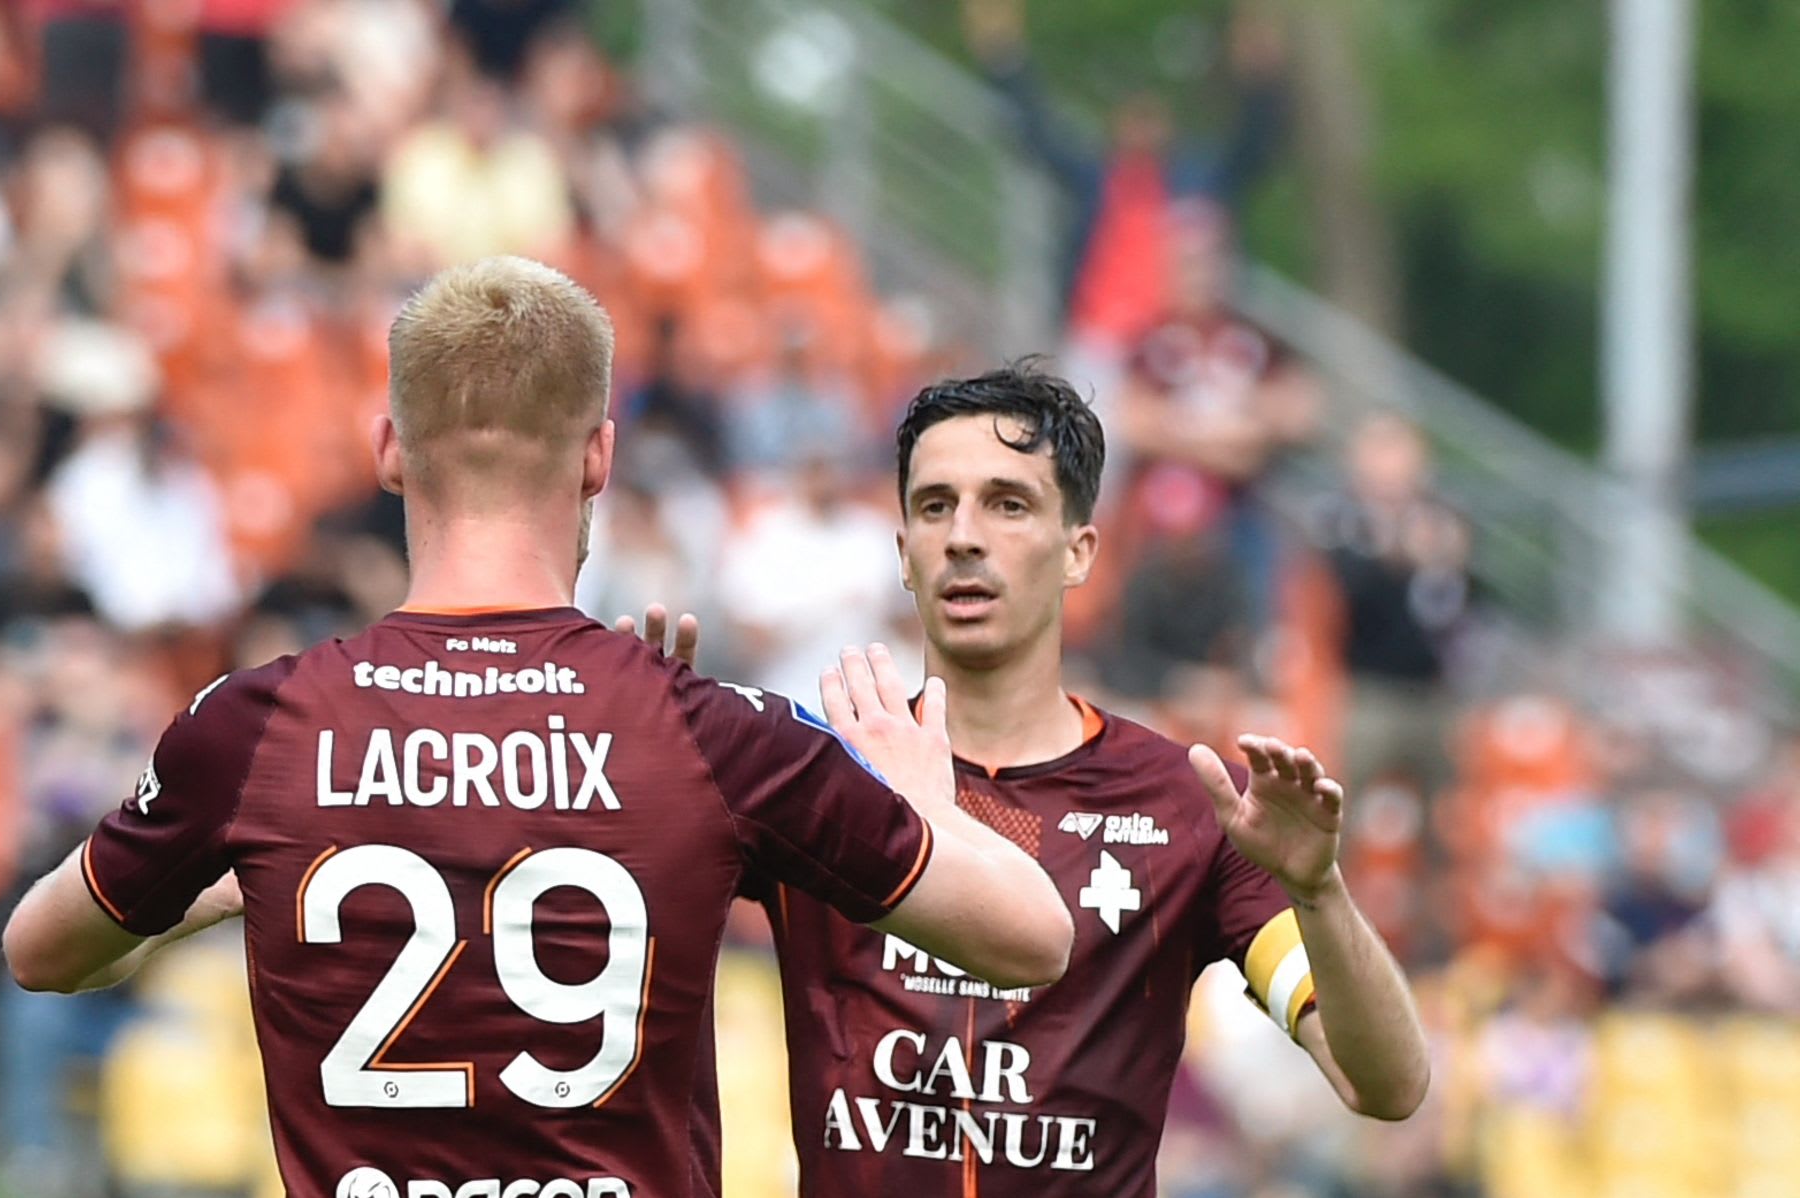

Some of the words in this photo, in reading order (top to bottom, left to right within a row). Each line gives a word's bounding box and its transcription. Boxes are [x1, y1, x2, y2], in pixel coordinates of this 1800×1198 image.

[446, 638, 469, 651] Fc
[472, 637, 517, 653] Metz
[296, 843, 655, 1109] 29
[873, 1028, 1033, 1104] CAR
[824, 1088, 1097, 1171] AVENUE
